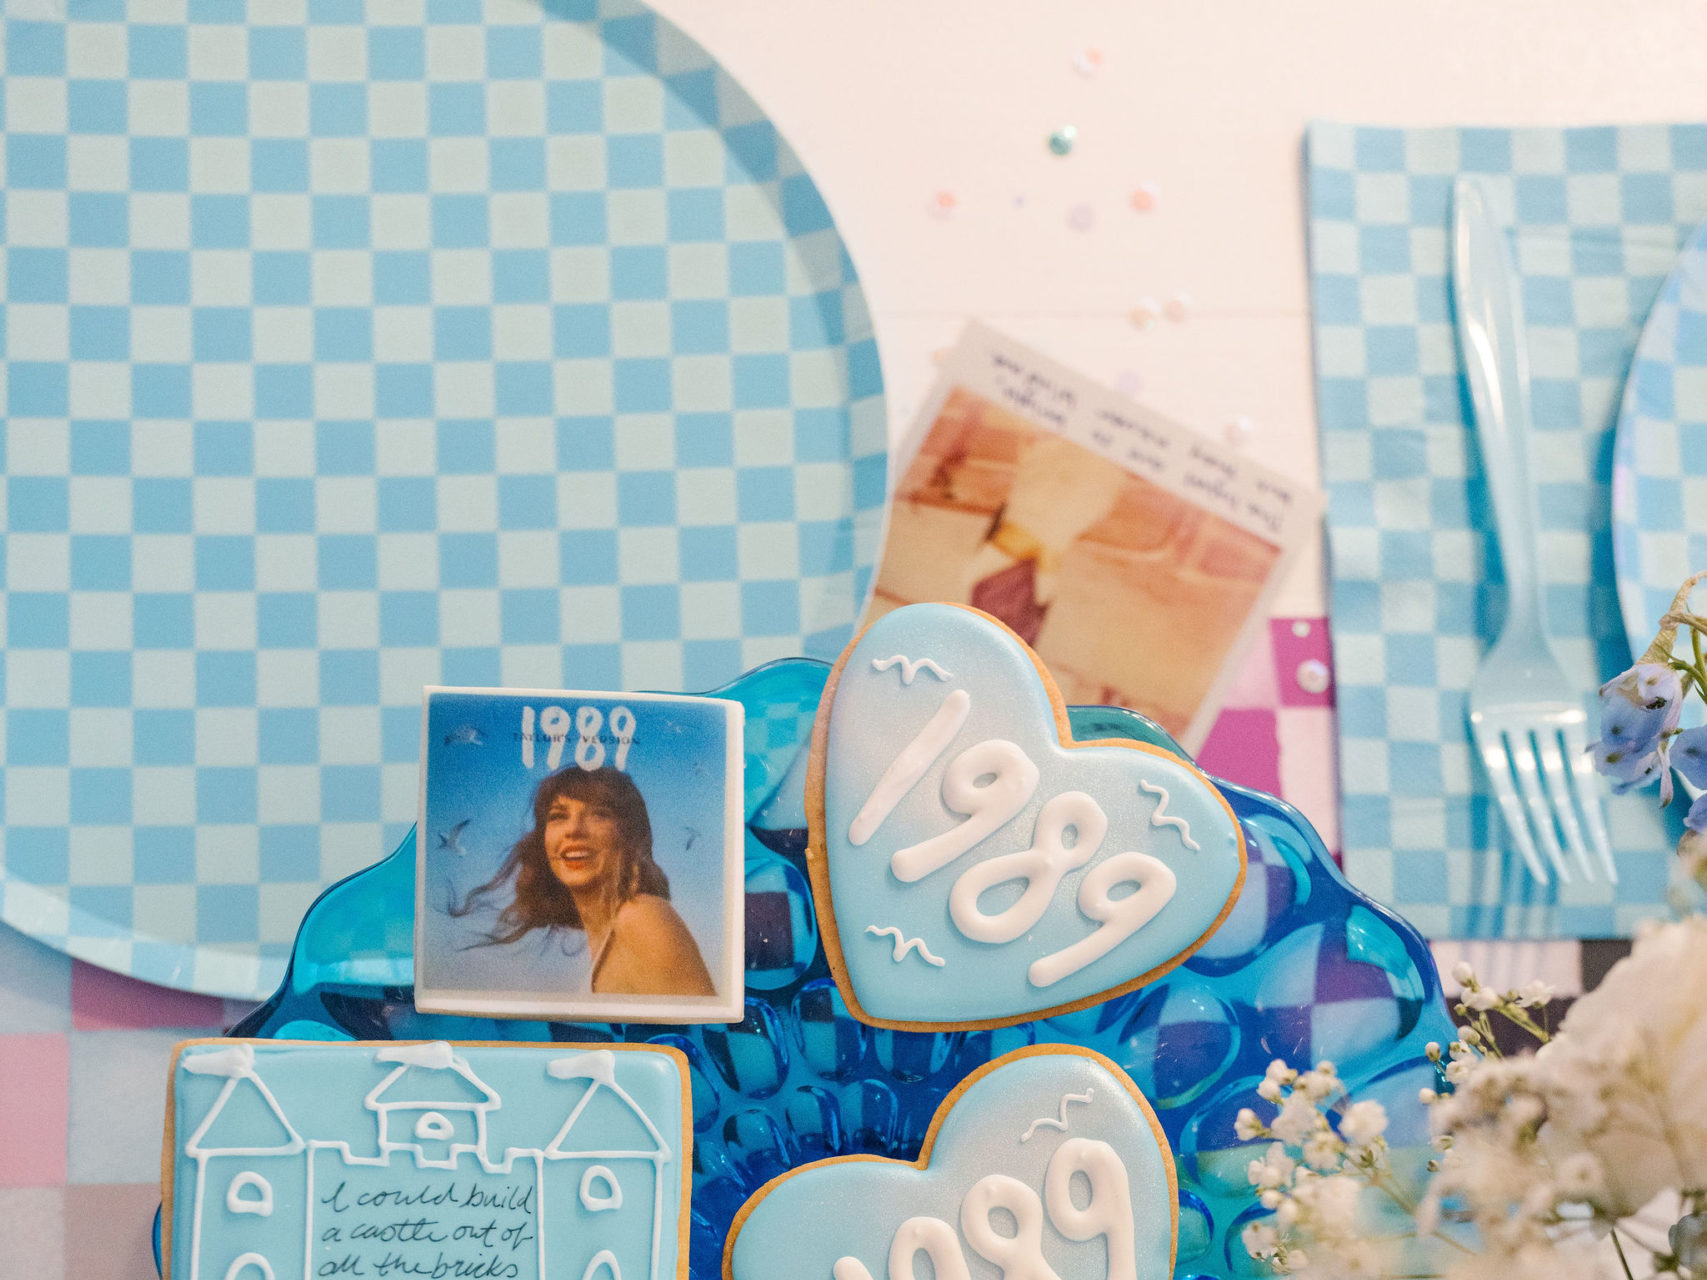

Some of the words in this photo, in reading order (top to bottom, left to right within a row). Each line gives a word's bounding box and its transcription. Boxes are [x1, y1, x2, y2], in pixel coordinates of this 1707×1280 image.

[522, 705, 637, 772] 1989
[848, 689, 1177, 988] 1989
[357, 1182, 457, 1207] could
[459, 1183, 532, 1214] build
[322, 1227, 341, 1242] a
[350, 1218, 447, 1242] castle
[453, 1219, 497, 1247] out
[501, 1222, 533, 1251] of
[318, 1254, 364, 1277] all
[373, 1252, 432, 1277] the
[431, 1252, 518, 1279] bricks
